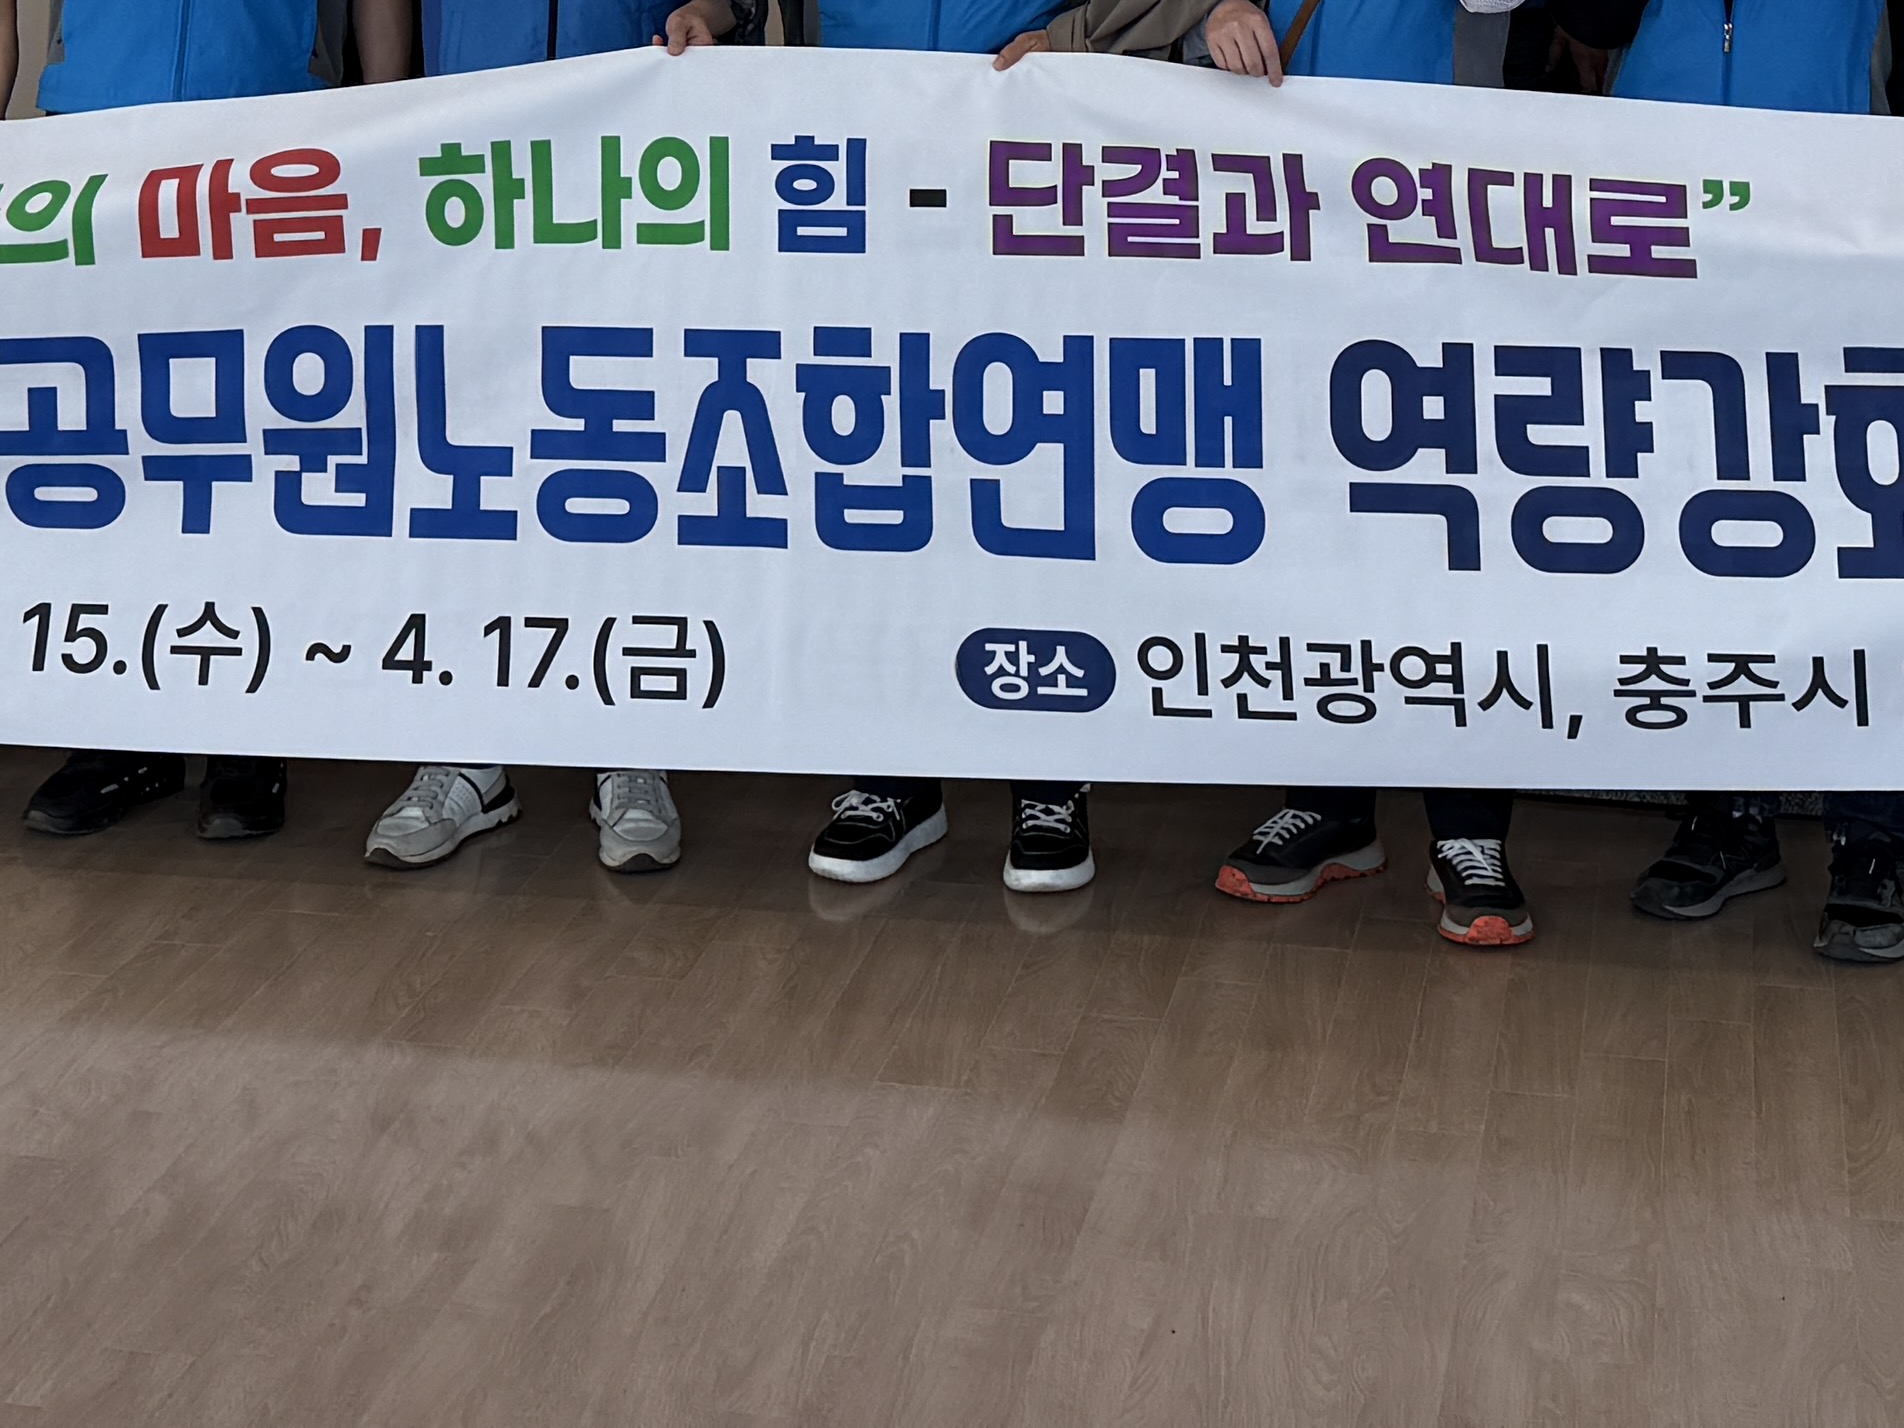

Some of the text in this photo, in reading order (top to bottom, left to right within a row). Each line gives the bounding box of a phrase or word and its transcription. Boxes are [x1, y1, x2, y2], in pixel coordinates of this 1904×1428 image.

[138, 148, 382, 262] 마음,
[419, 135, 730, 251] 하나의
[770, 135, 867, 254] 힘
[988, 140, 1321, 262] 단결과
[1351, 157, 1750, 279] 연대로”
[22, 600, 272, 694] 15.(수)
[305, 642, 352, 664] ~
[381, 612, 454, 687] 4.
[483, 614, 726, 710] 17.(금)
[984, 640, 1088, 700] 장소
[1136, 632, 1584, 740] 인천광역시,
[1612, 646, 1870, 730] 충주시
